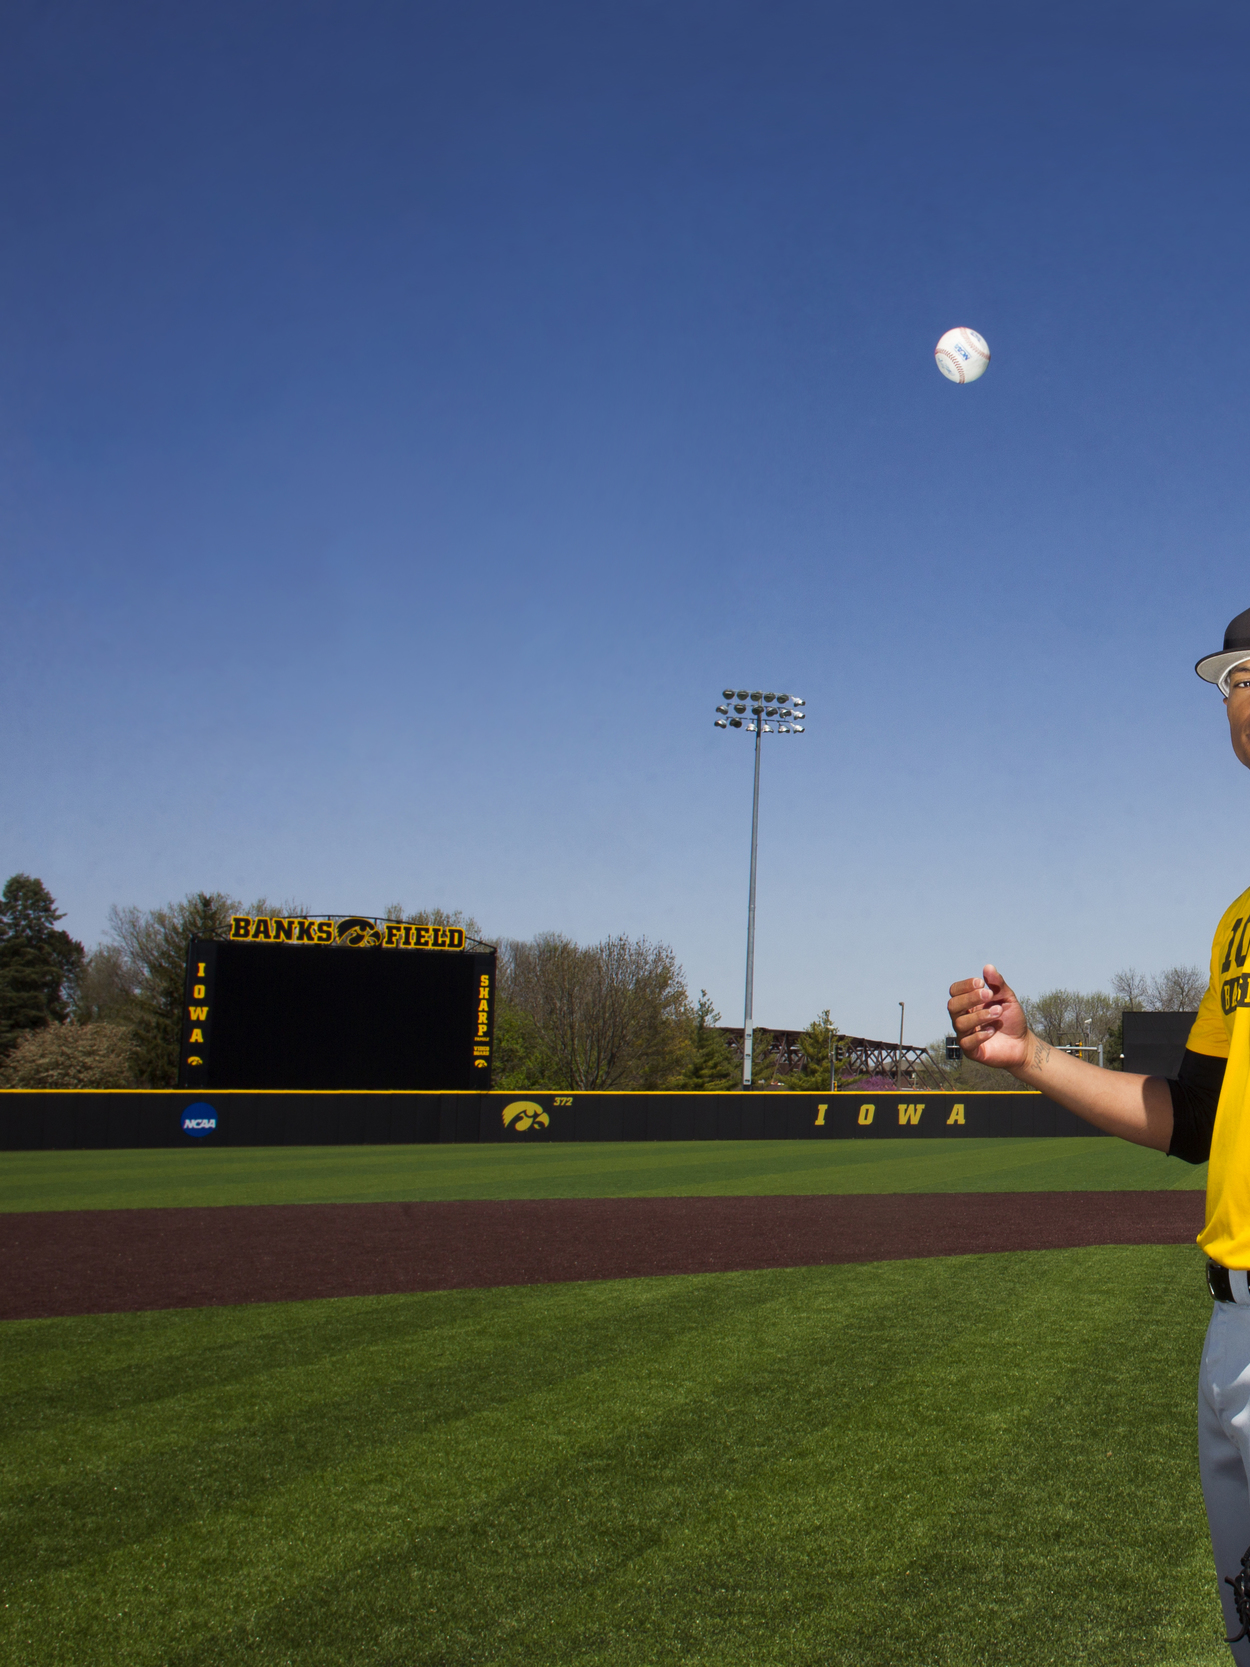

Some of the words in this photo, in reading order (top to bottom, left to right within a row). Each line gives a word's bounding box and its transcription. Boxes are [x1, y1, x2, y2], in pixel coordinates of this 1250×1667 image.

[230, 915, 334, 944] BANKS
[384, 923, 465, 950] FIELD
[188, 963, 209, 1043] IOWA
[477, 974, 489, 1036] SHARP
[553, 1096, 574, 1106] 372
[814, 1103, 966, 1126] IOWA
[183, 1118, 217, 1129] NCAA
